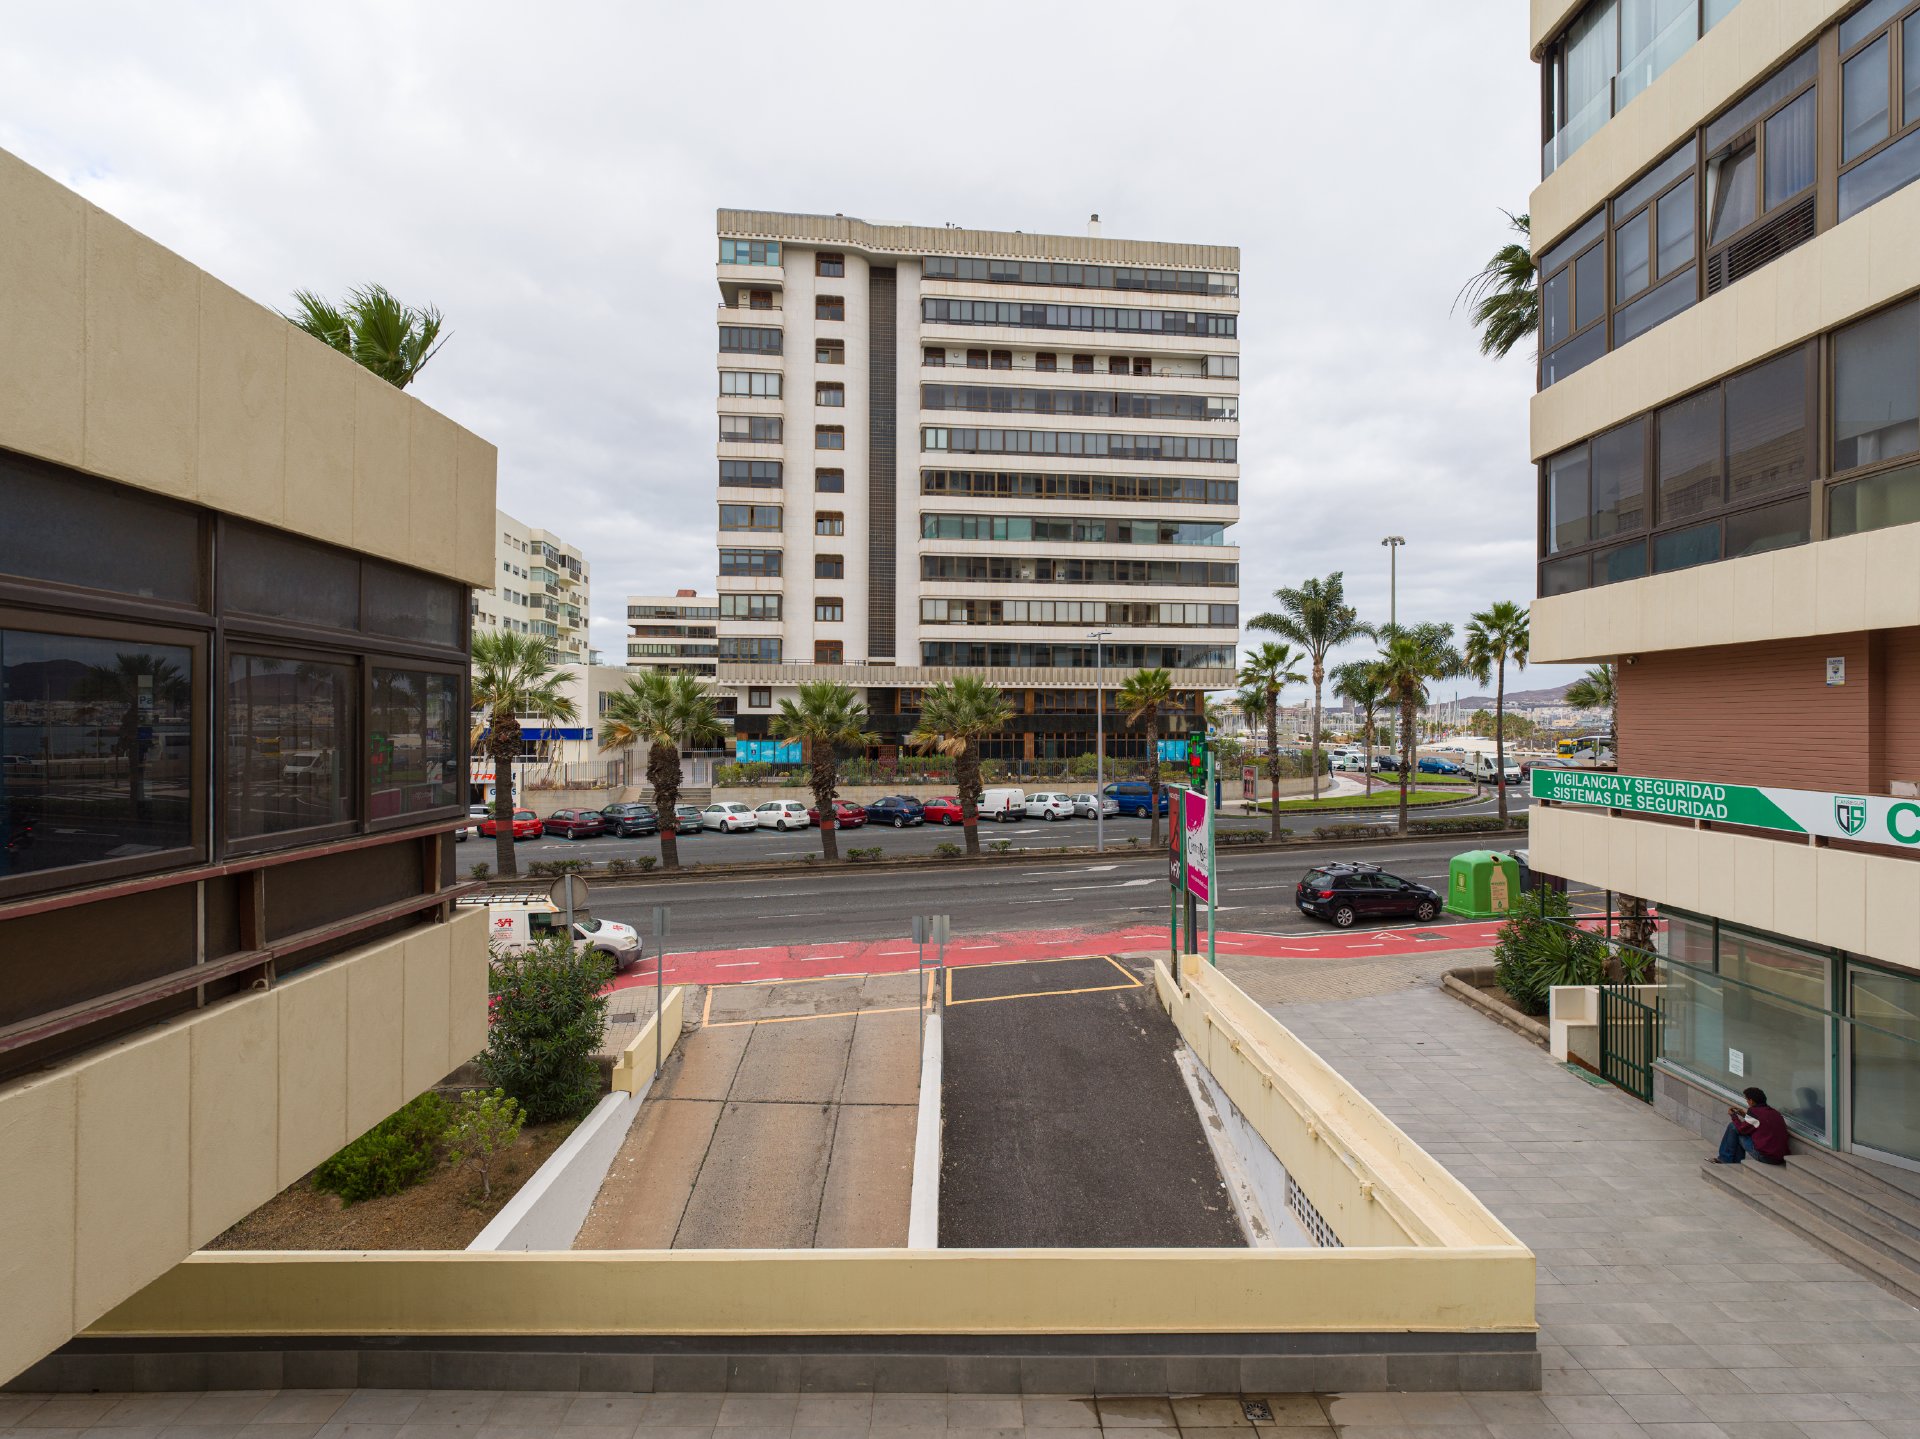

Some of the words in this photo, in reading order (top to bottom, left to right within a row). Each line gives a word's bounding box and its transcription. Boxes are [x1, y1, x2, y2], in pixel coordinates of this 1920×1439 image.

[1553, 772, 1621, 791] VIGILANCIA
[1622, 778, 1632, 792] Y
[1635, 780, 1726, 802] SEGURIDAD
[1553, 786, 1611, 805] SISTEMAS
[1615, 793, 1633, 808] DE
[1636, 795, 1728, 819] SEGURIDAD
